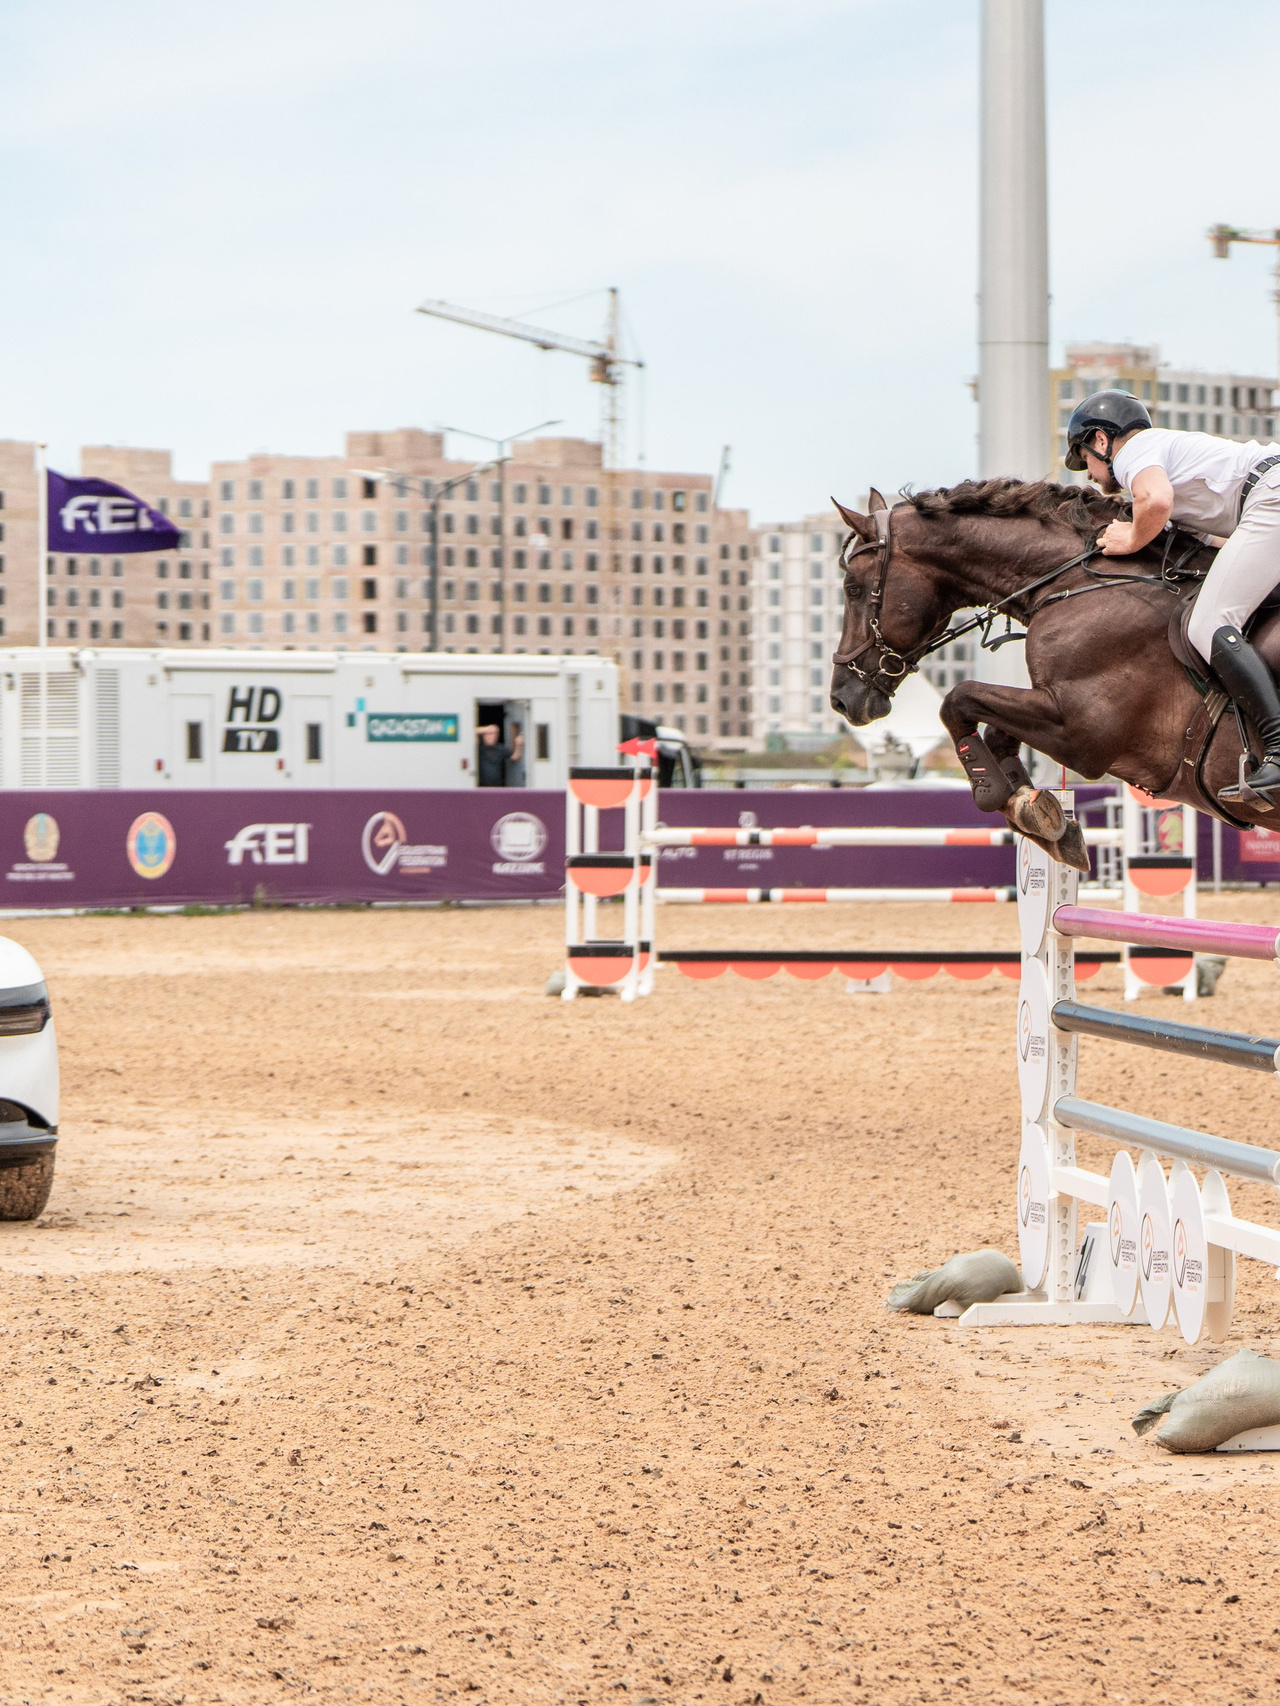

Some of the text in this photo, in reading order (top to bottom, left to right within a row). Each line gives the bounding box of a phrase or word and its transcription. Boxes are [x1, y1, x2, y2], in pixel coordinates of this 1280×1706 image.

[227, 686, 281, 722] HD
[236, 731, 267, 750] TV
[224, 823, 308, 864] FEI
